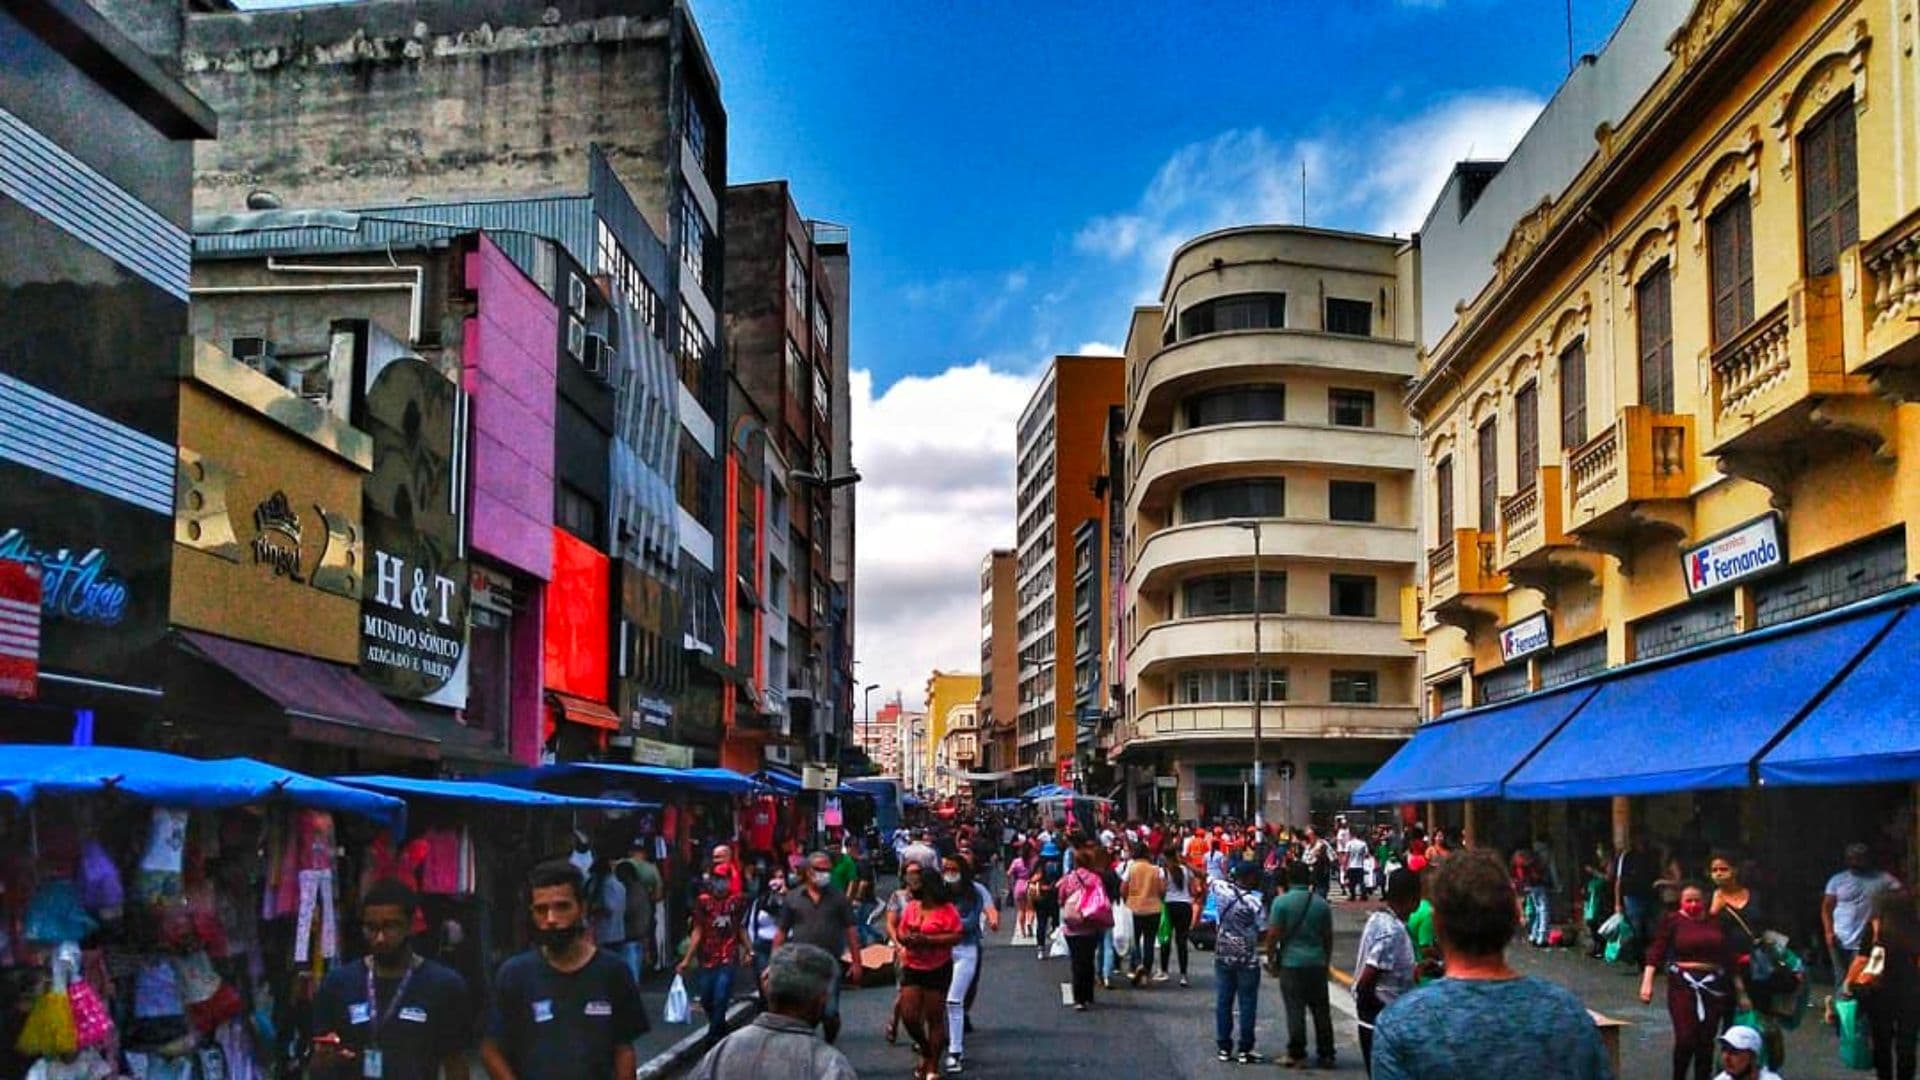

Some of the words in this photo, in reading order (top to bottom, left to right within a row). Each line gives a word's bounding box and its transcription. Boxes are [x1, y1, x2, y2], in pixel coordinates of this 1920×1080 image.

[375, 550, 404, 610] H
[410, 567, 430, 617] &
[435, 574, 455, 625] T
[364, 614, 416, 648] MUNDO
[367, 645, 411, 668] ATACADO
